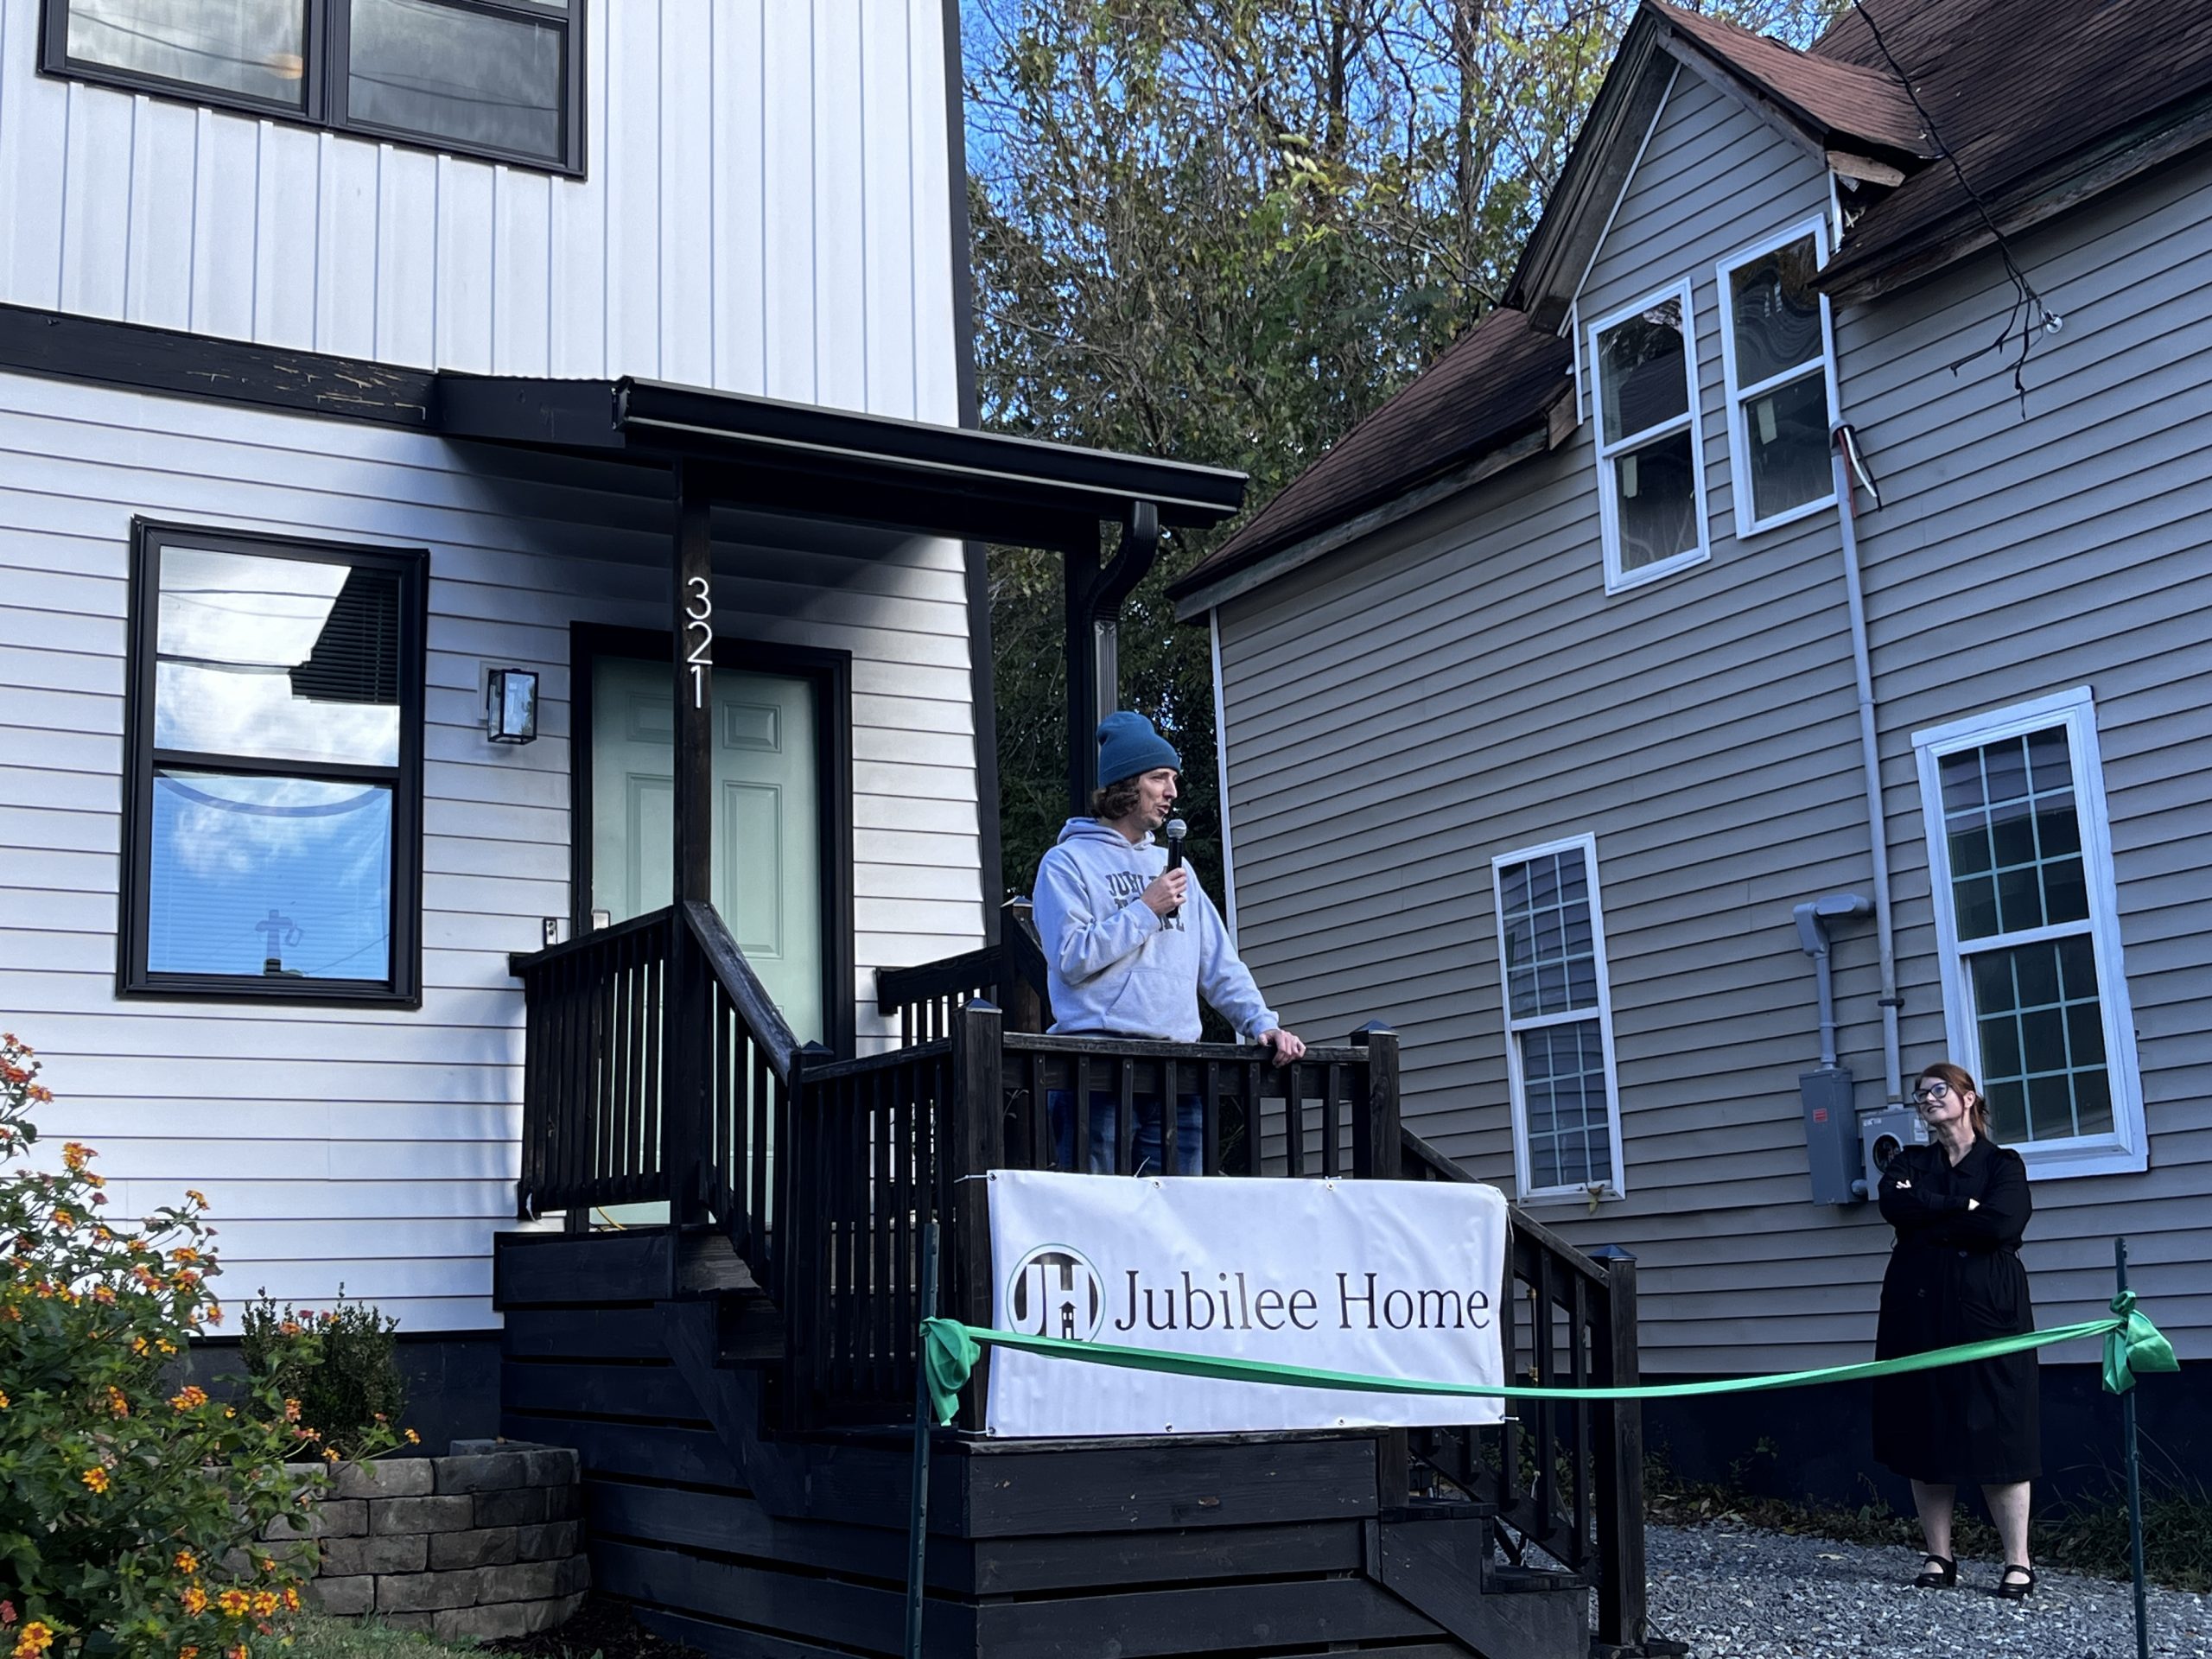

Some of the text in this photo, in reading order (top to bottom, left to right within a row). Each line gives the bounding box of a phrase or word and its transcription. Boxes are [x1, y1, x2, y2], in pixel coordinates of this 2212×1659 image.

[685, 576, 713, 709] 321
[1115, 1270, 1490, 1332] Jubilee Home
